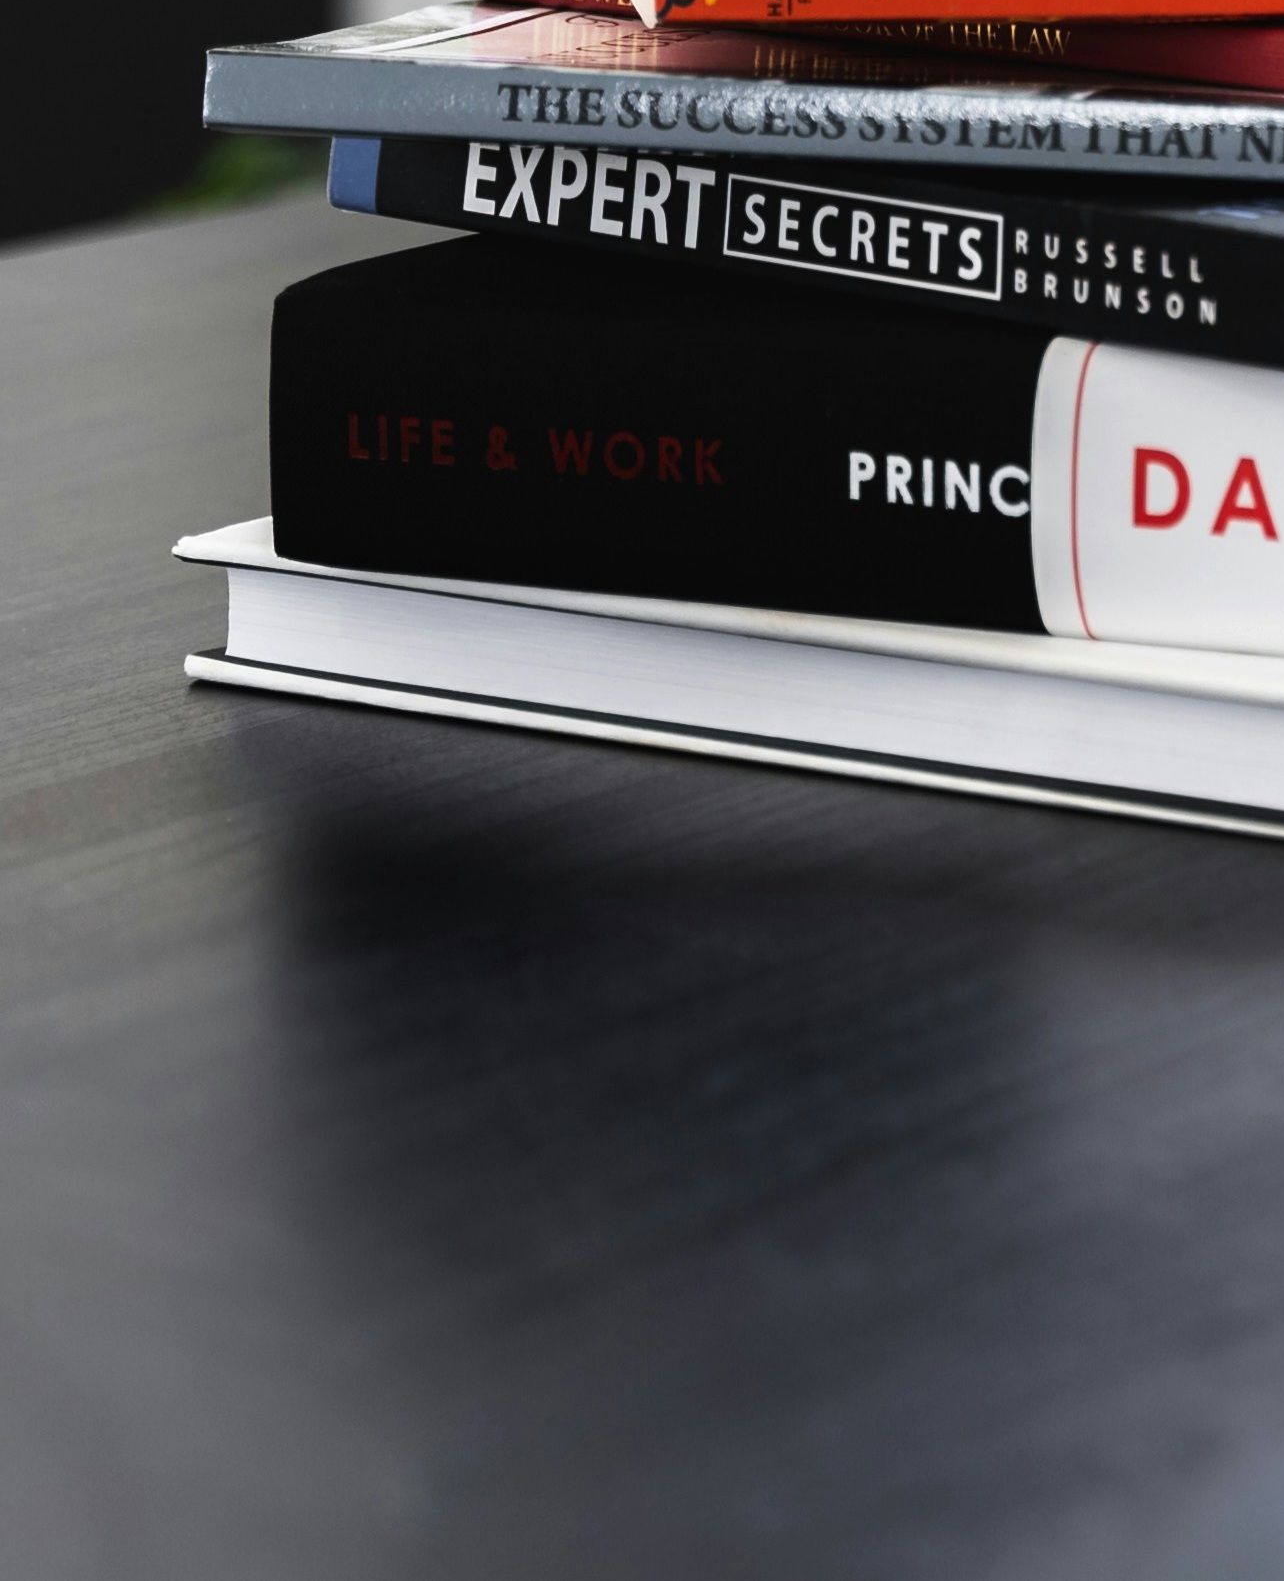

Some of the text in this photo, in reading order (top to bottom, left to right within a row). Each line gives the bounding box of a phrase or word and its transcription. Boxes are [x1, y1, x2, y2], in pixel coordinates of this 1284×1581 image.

[1010, 24, 1072, 56] LAW
[498, 83, 605, 126] THE
[616, 87, 847, 140] SUCCESS
[463, 142, 984, 281] EXPERT SECRETS
[1015, 230, 1204, 283] RUSSELL
[1014, 268, 1217, 326] BRUNSON
[347, 413, 726, 486] LIFE & WORK
